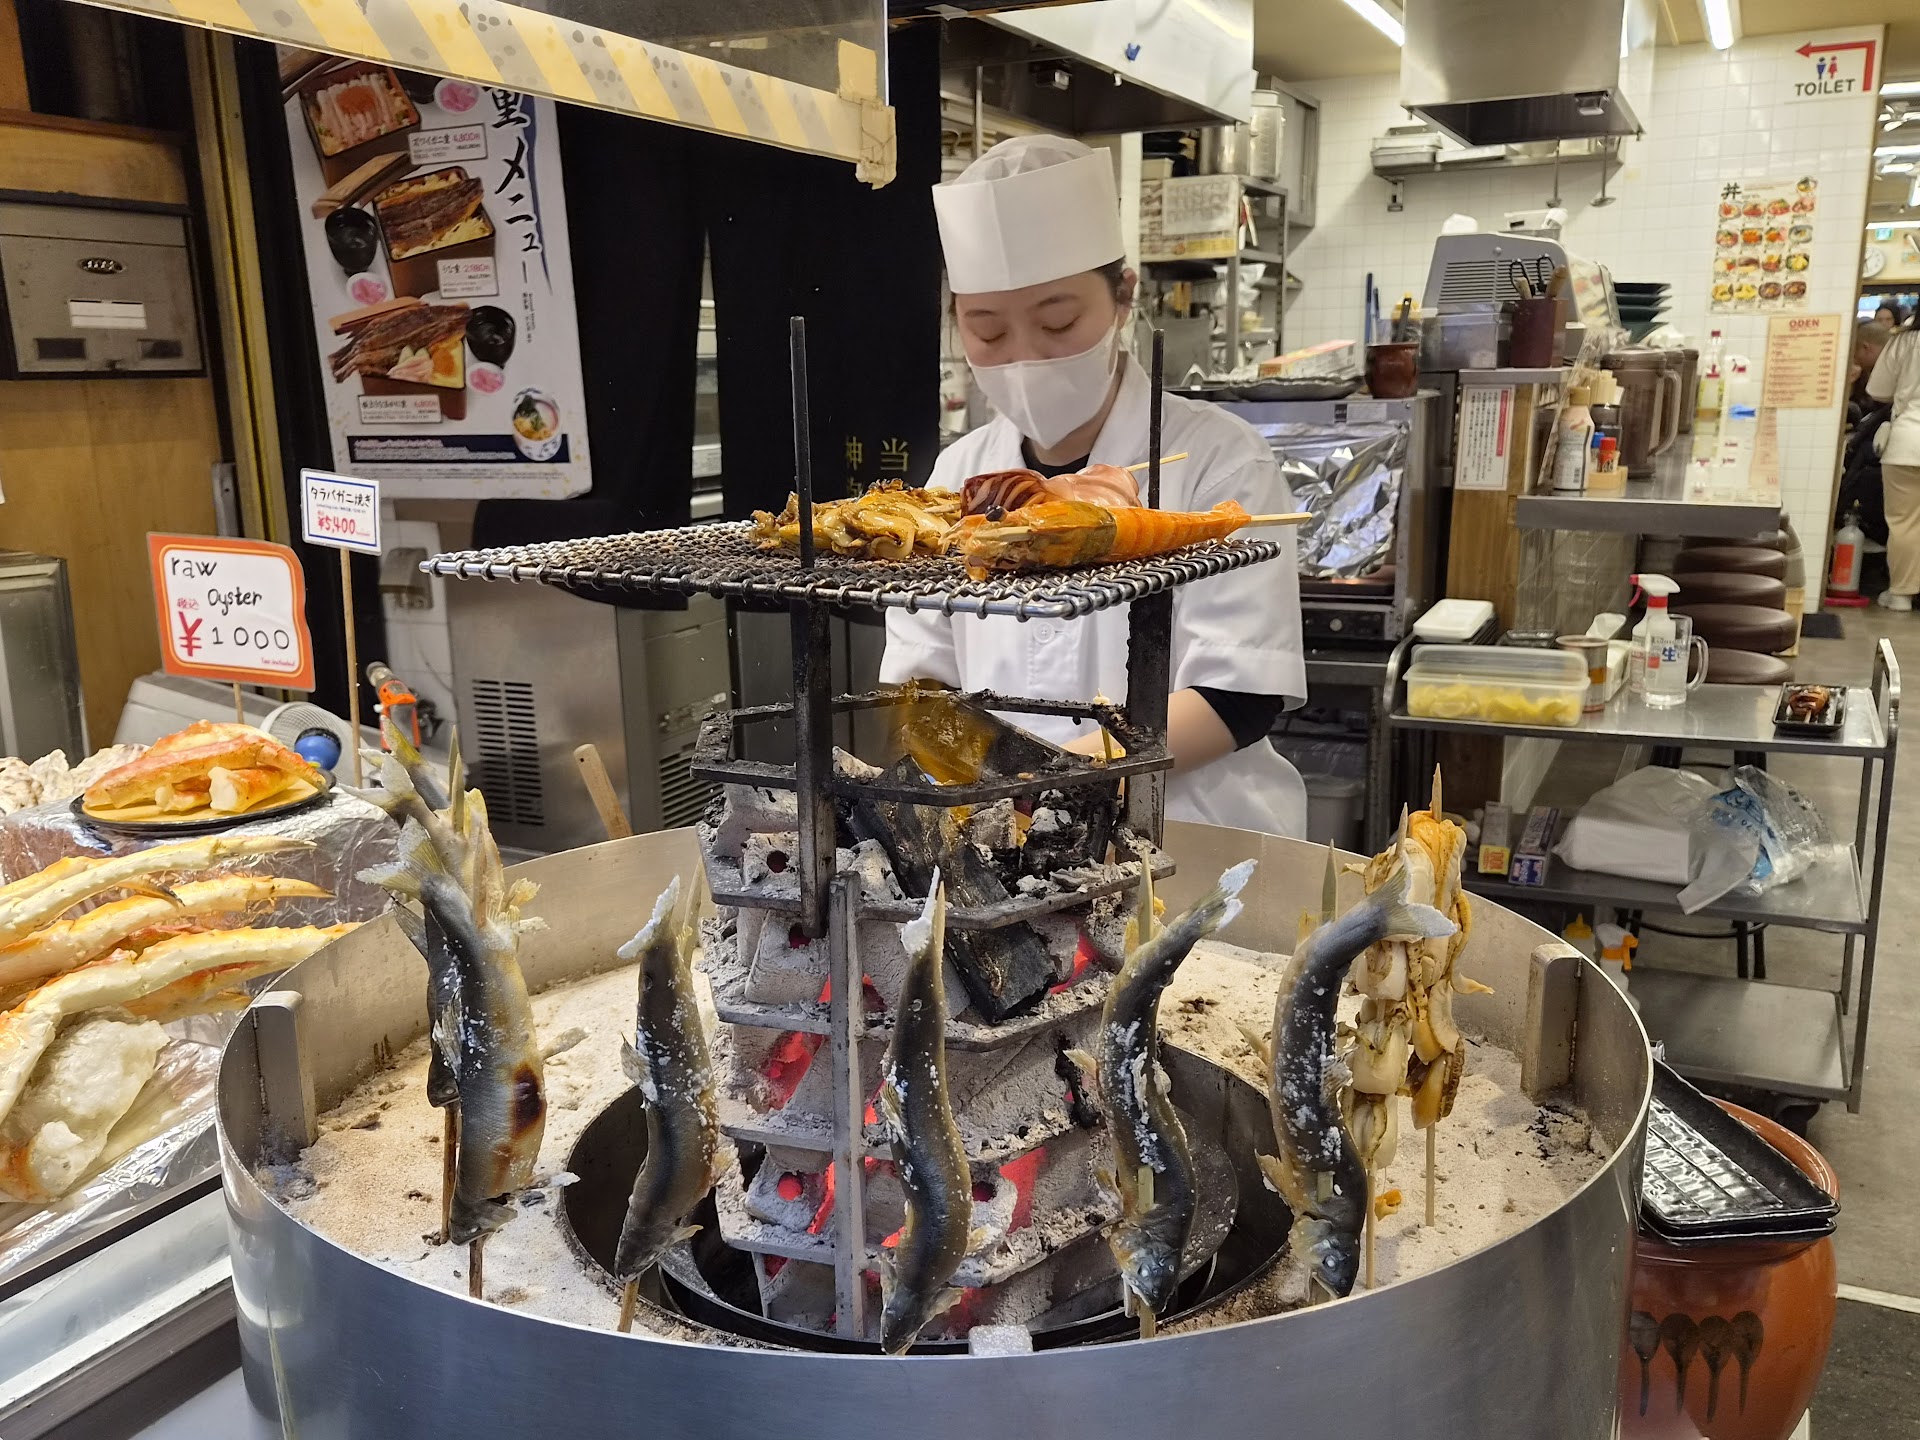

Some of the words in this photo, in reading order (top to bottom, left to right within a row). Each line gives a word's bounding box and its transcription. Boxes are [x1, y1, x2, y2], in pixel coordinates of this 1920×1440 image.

[1795, 79, 1856, 96] TOILET
[1789, 319, 1820, 328] ODEN
[318, 515, 356, 535] ¥5,400
[171, 557, 217, 578] raw
[207, 586, 262, 616] Oyster
